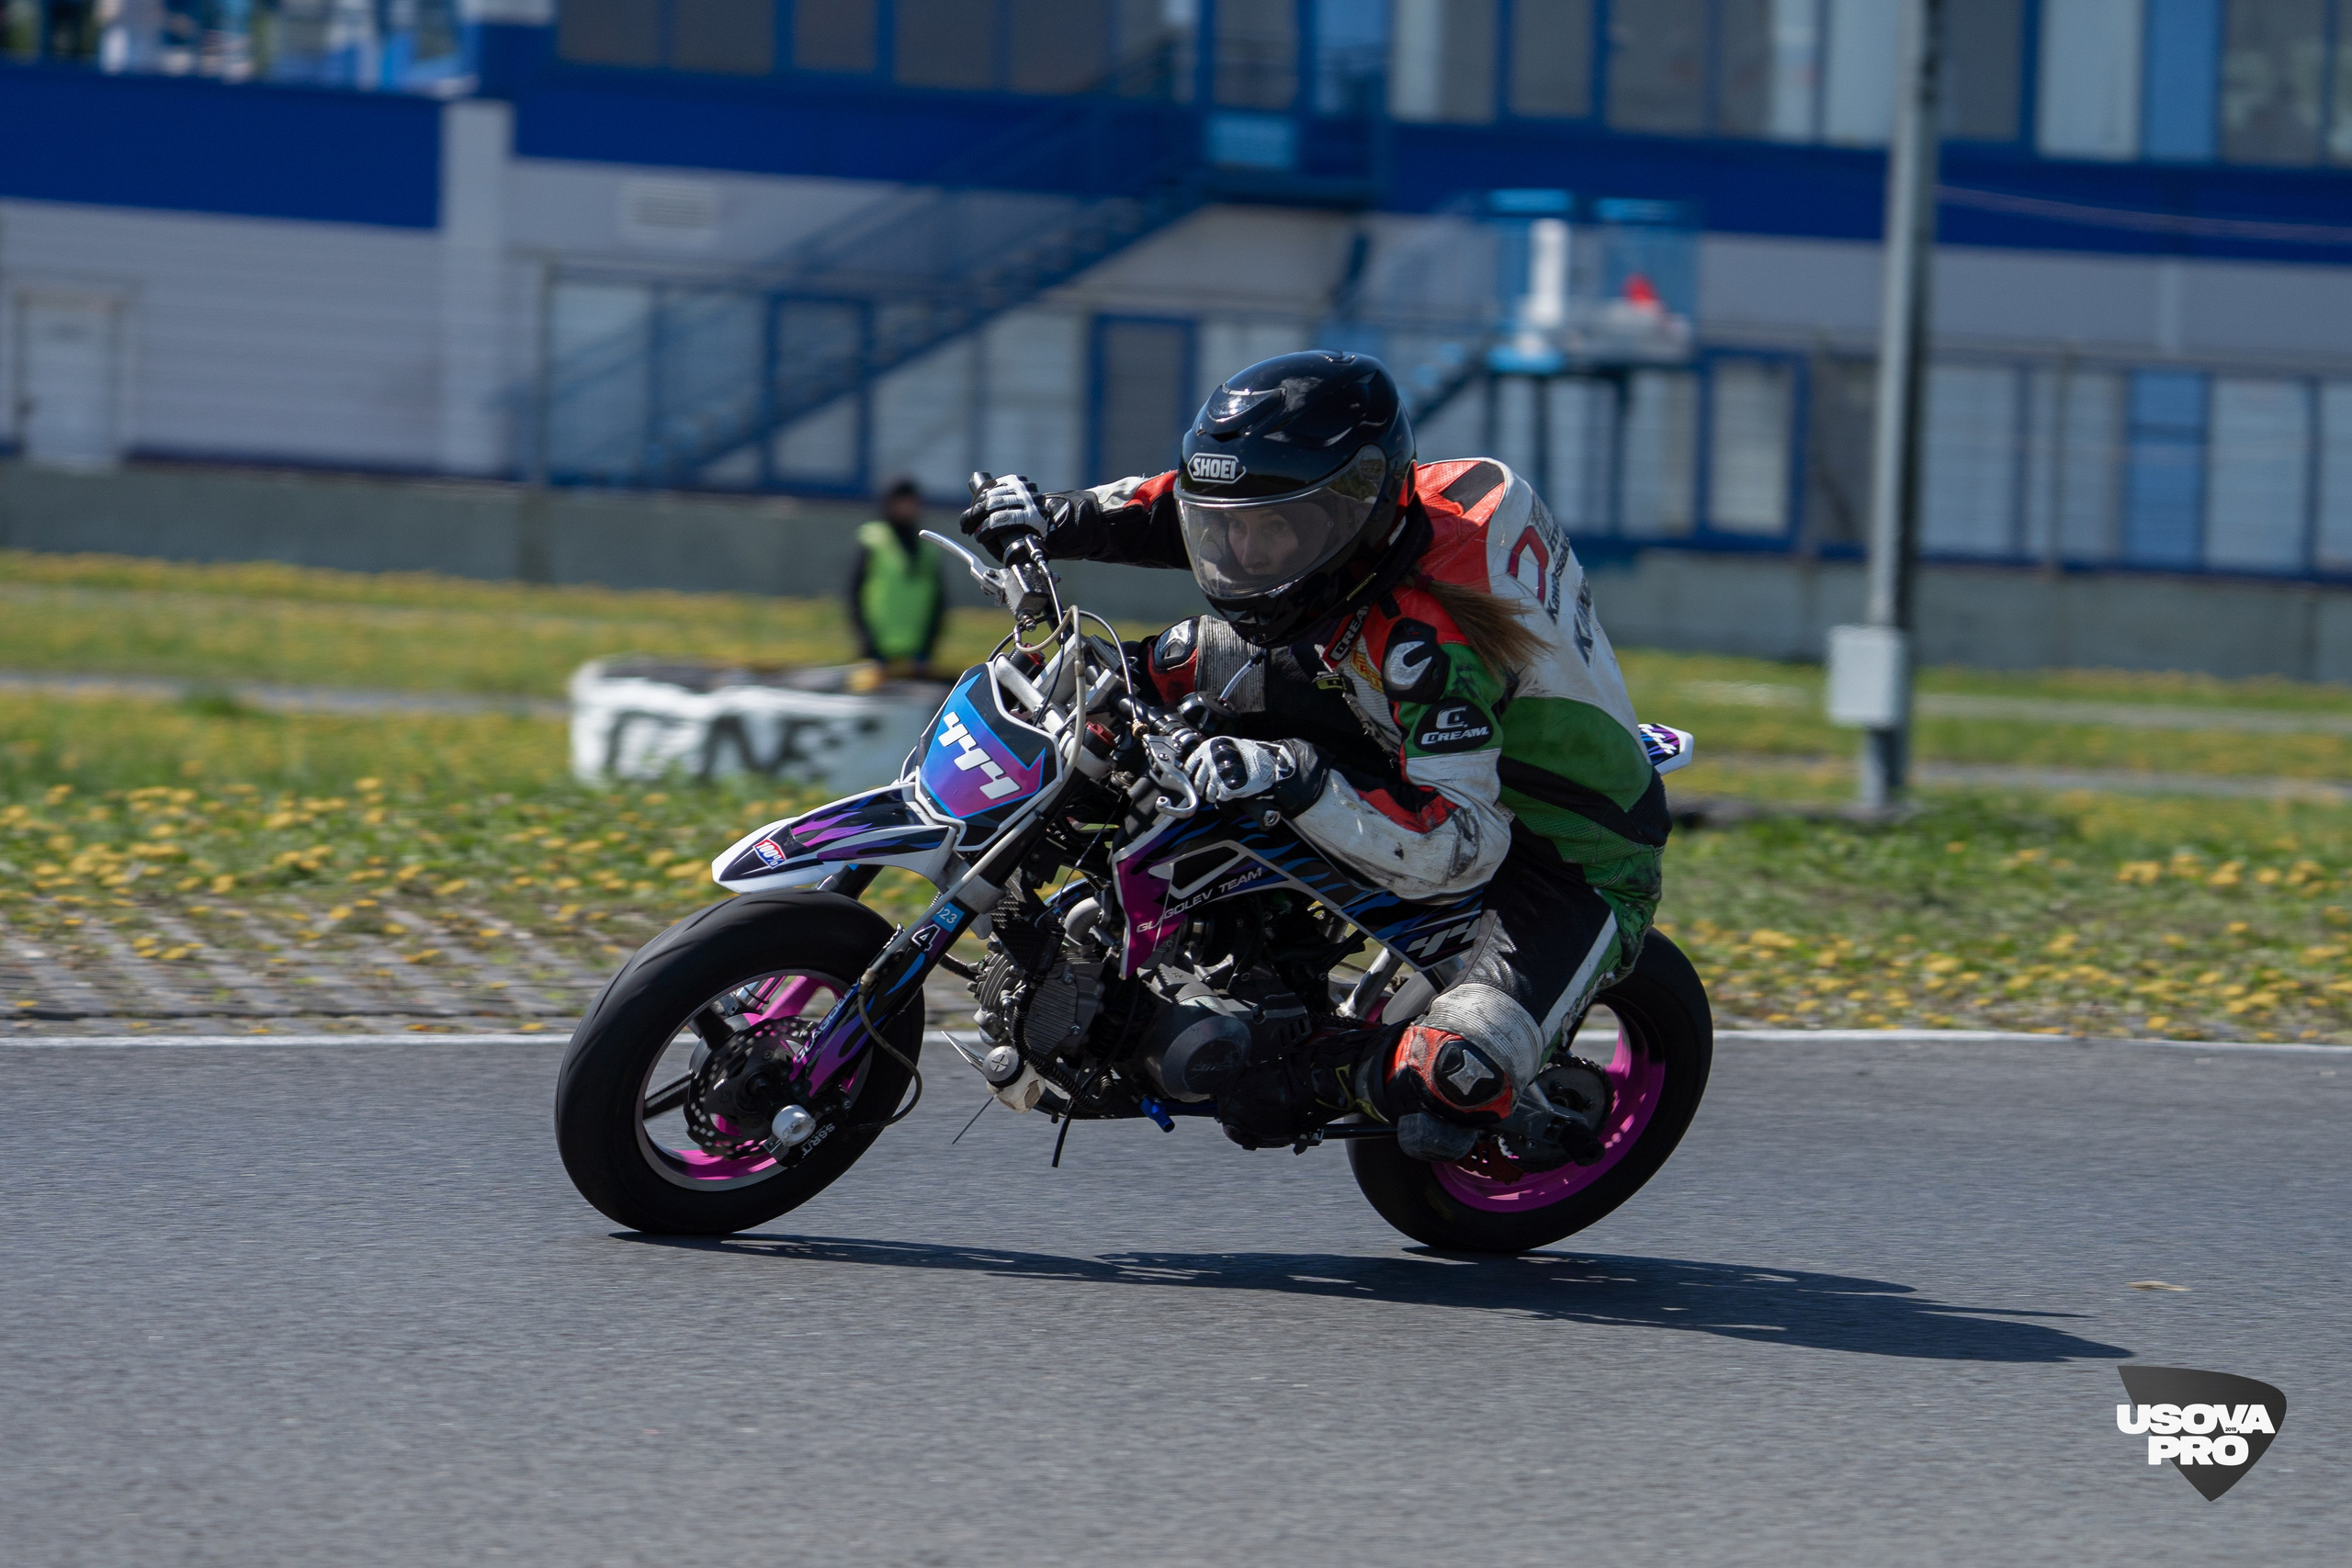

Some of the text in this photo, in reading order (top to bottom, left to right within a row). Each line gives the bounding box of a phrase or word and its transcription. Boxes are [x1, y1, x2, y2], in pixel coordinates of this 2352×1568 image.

[1193, 457, 1237, 479] SHOEI
[938, 711, 1022, 800] 444
[754, 841, 784, 866] 100%
[1218, 866, 1263, 894] TEAM
